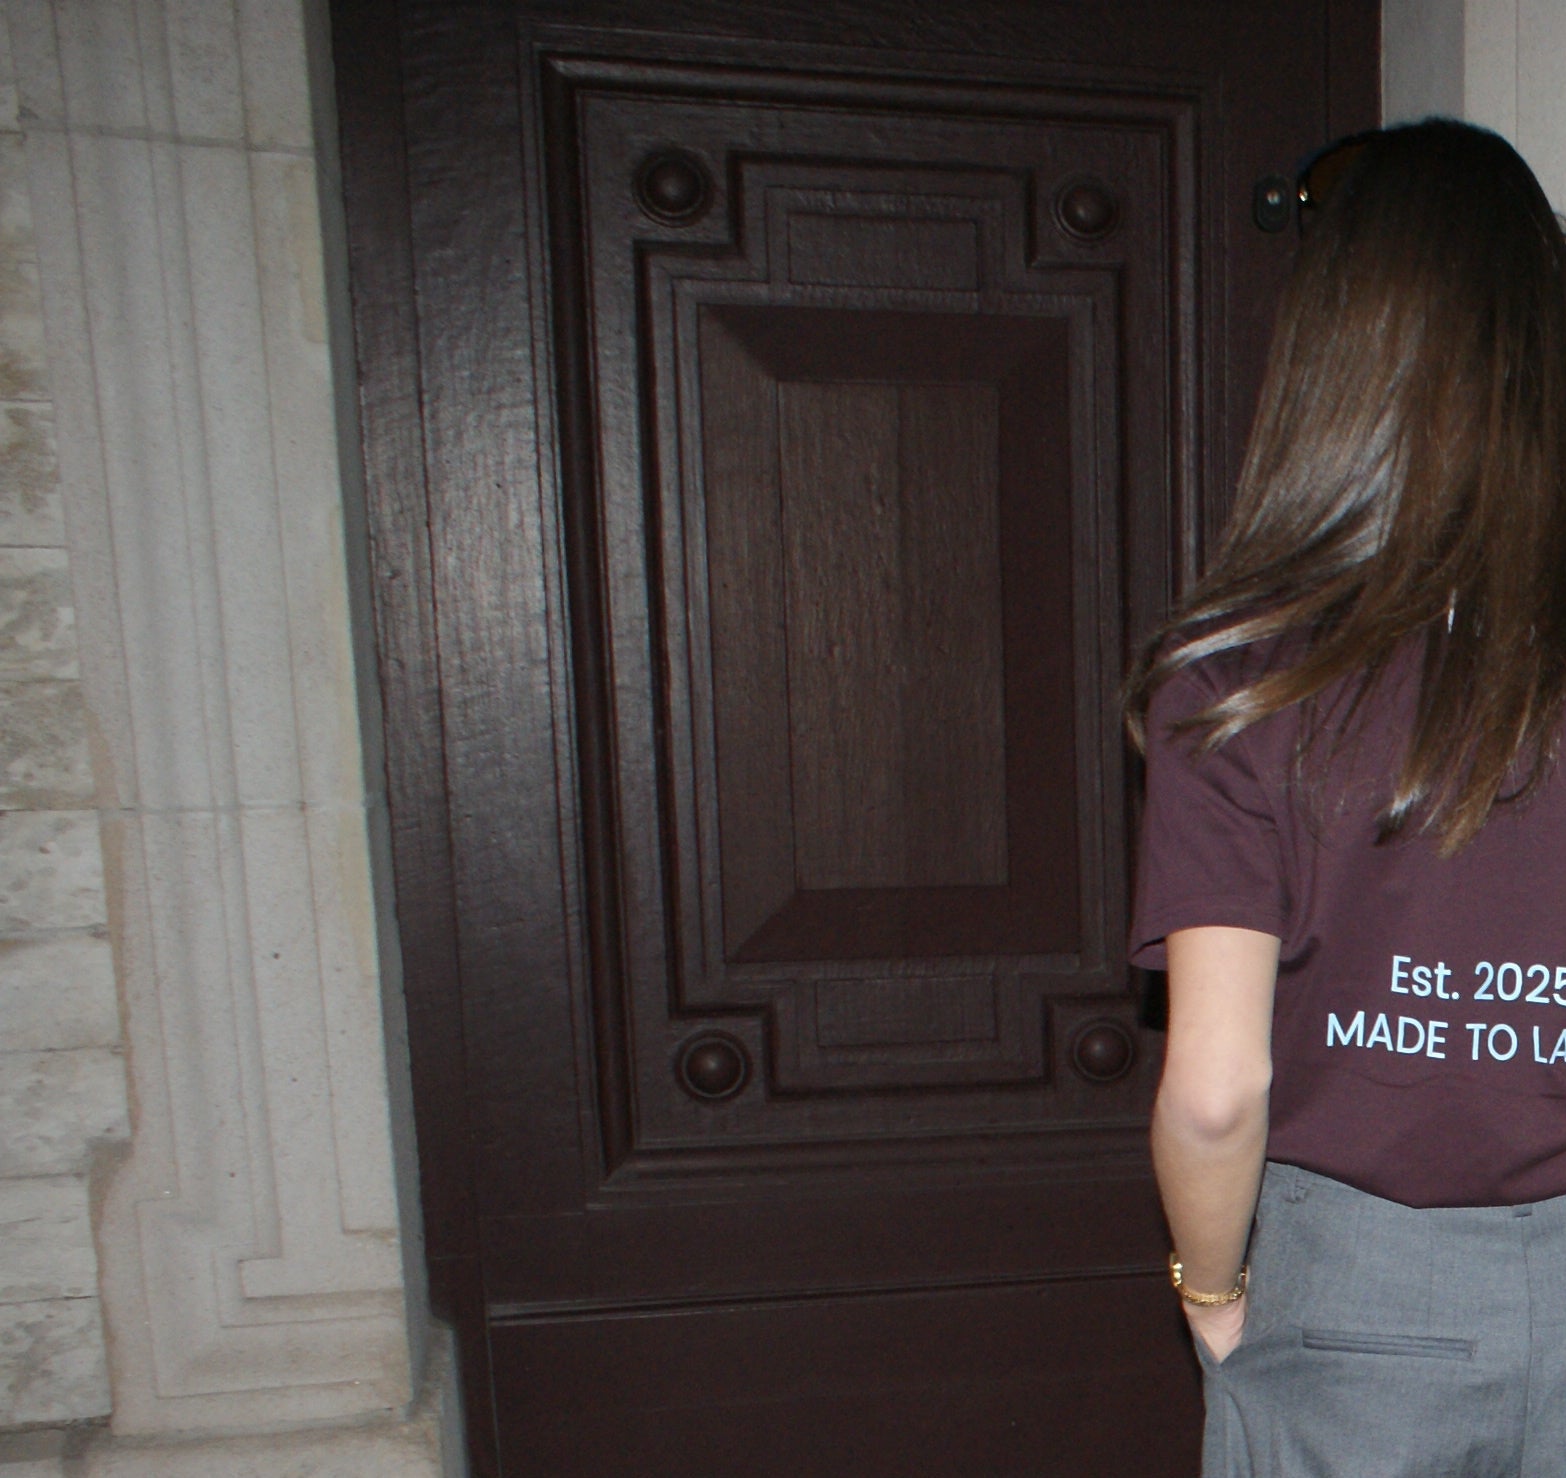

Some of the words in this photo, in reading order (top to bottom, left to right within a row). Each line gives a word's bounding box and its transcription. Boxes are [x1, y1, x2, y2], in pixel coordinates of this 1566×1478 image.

[1389, 953, 1461, 1001] Est.
[1325, 1009, 1450, 1060] MADE
[1464, 1021, 1519, 1062] TO
